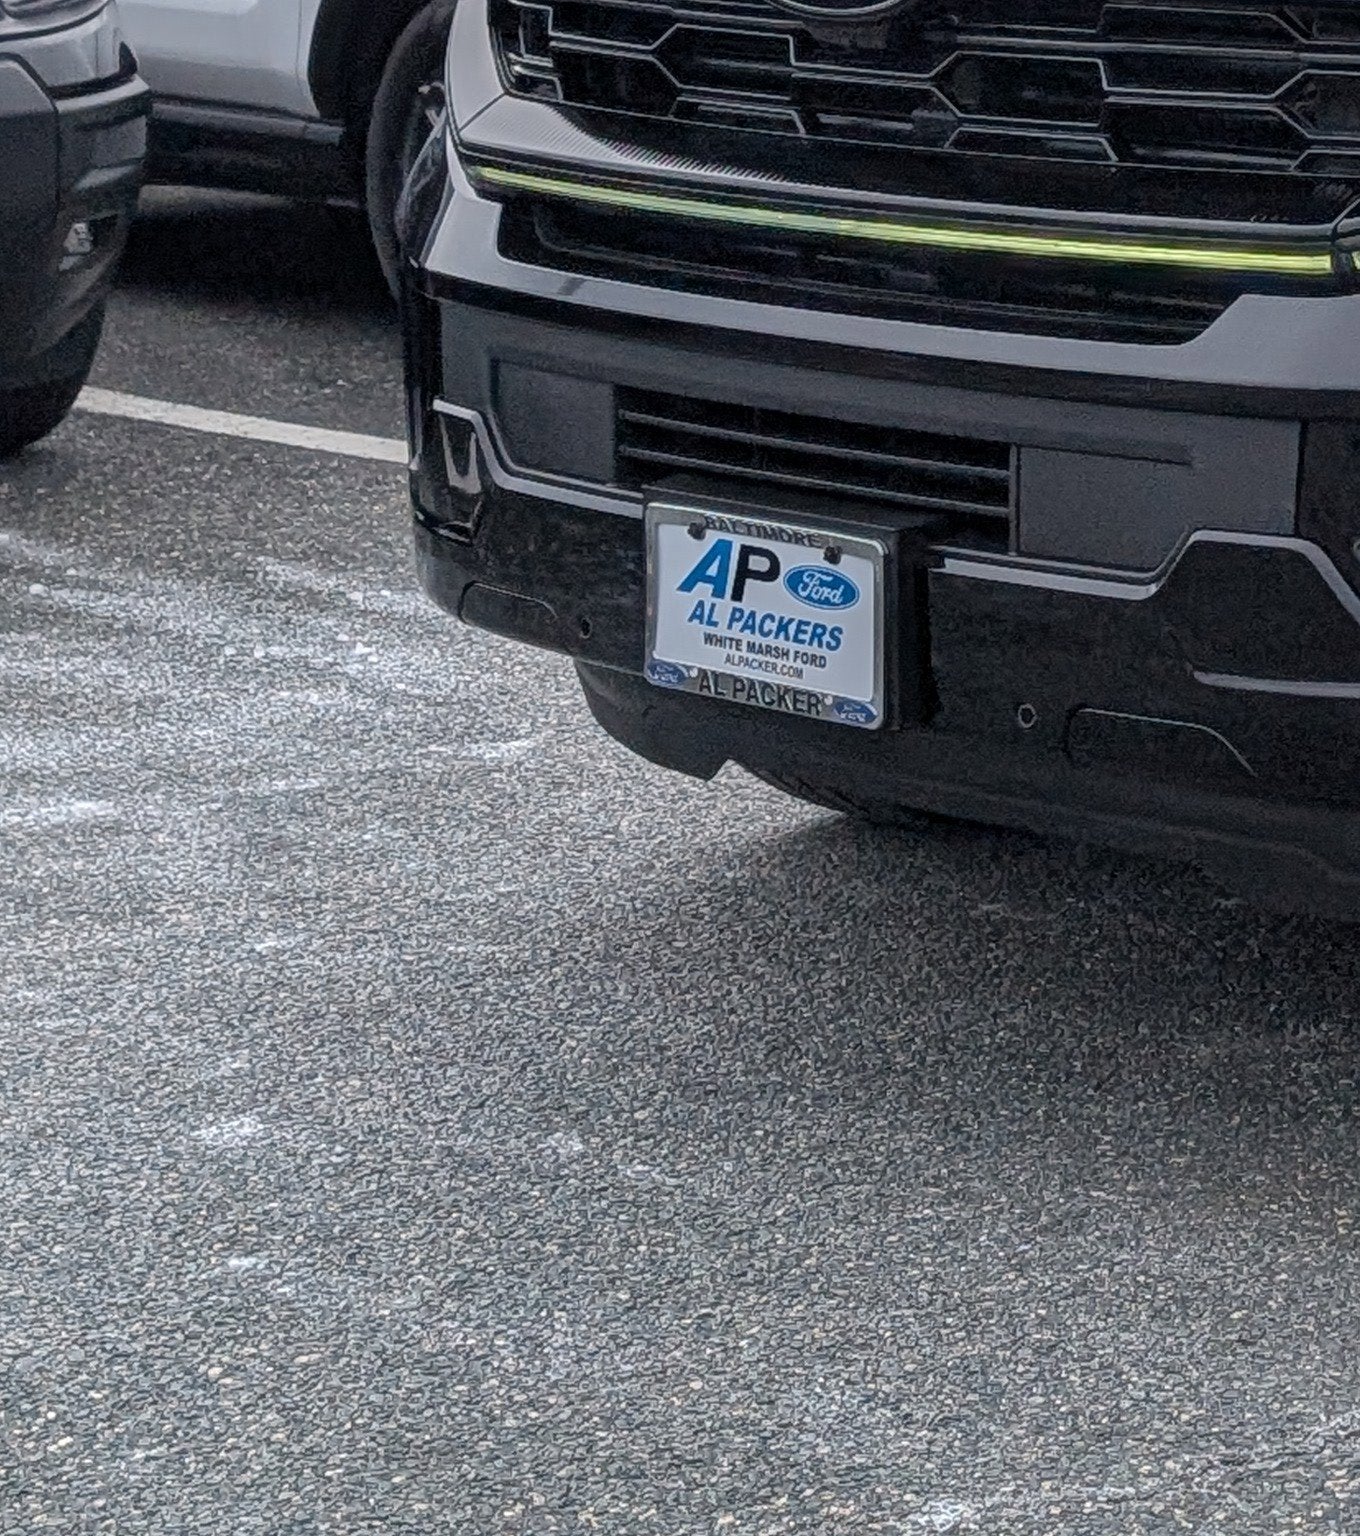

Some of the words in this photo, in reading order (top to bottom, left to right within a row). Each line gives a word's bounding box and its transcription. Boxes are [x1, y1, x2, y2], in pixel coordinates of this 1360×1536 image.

[704, 515, 823, 548] BALTIMORE
[676, 538, 781, 603] AP
[798, 570, 843, 604] Ford
[687, 600, 720, 627] AL
[727, 606, 843, 651] PACKERS
[703, 632, 743, 652] WHITE
[746, 640, 790, 661] MARSH
[793, 650, 827, 669] FORD
[724, 653, 804, 679] ALPACKER.COM
[699, 669, 727, 697] AL
